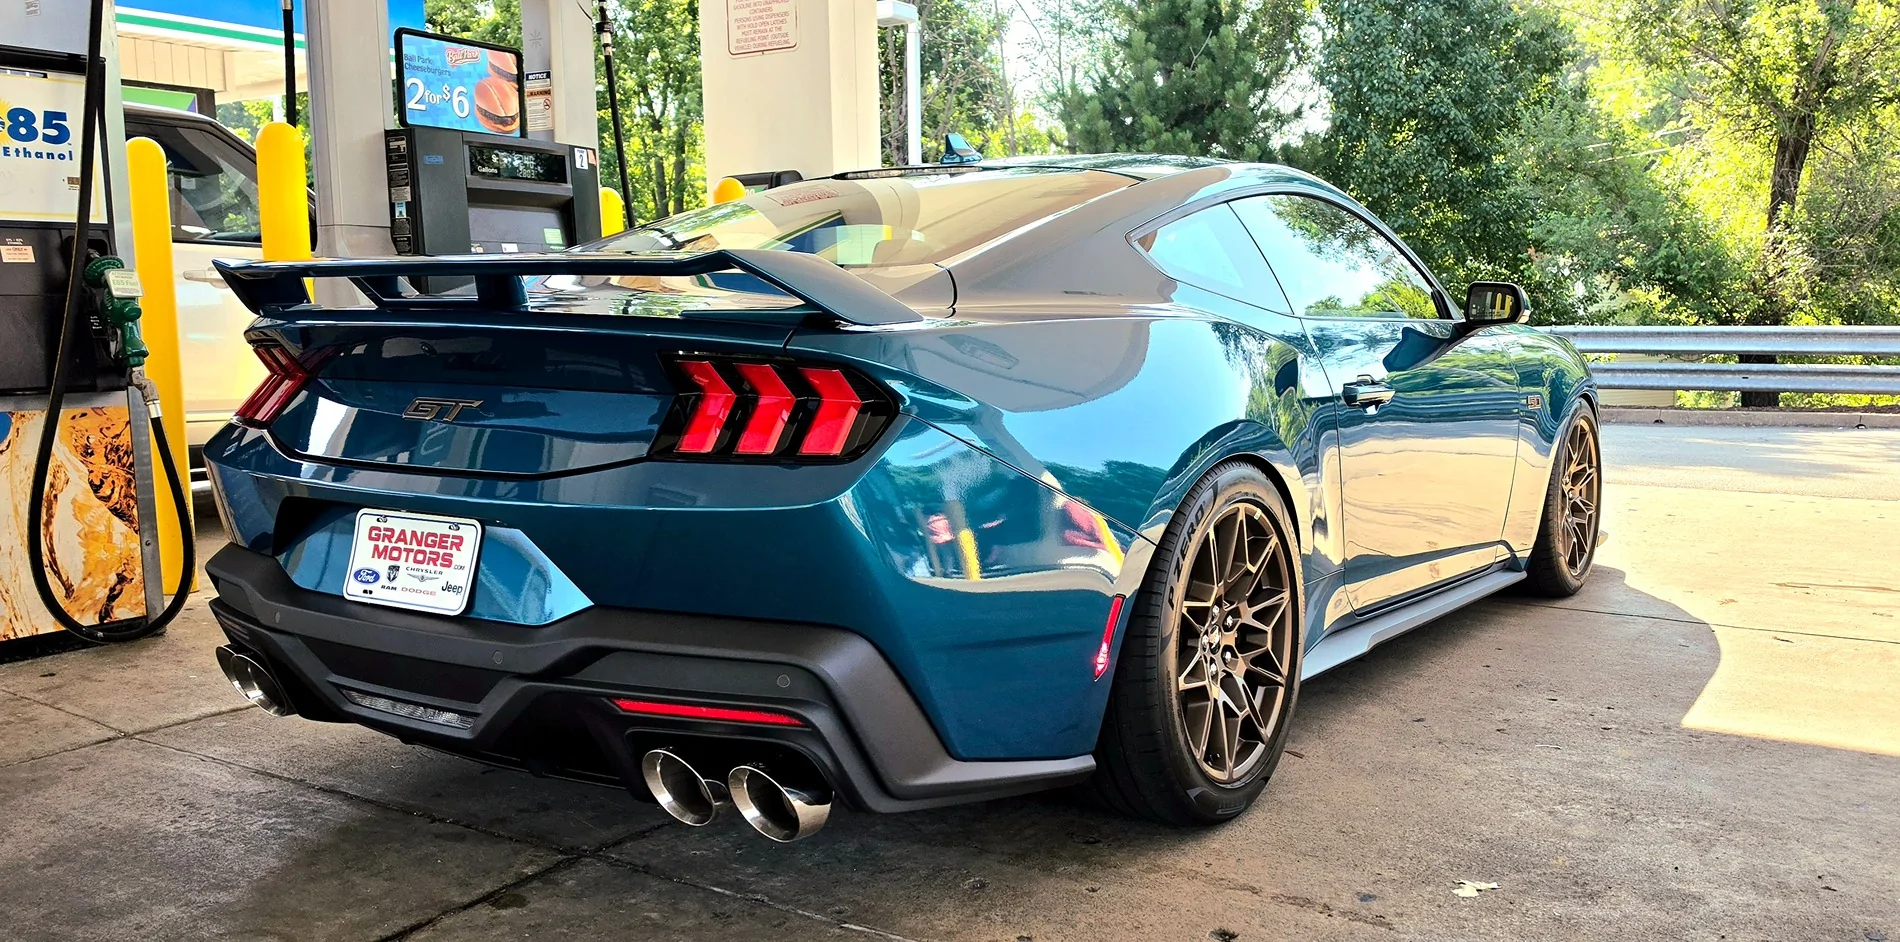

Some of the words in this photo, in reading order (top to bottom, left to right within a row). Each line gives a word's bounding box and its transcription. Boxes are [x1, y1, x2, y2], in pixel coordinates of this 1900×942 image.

[404, 53, 417, 61] Ball
[404, 62, 451, 77] Cheeseburgers
[406, 77, 426, 112] 2
[425, 89, 442, 104] for
[2, 146, 73, 161] Ethanol
[579, 154, 584, 168] 2
[477, 165, 498, 174] Gallons
[402, 396, 484, 422] GT
[368, 526, 464, 551] GRANGER
[371, 544, 454, 568] MOTORS
[1168, 585, 1175, 611] P
[1174, 503, 1205, 583] ZERO
[357, 568, 377, 583] Ford
[405, 566, 443, 576] CHRYSLER
[401, 587, 436, 596] DODGE
[441, 580, 463, 595] Jeep
